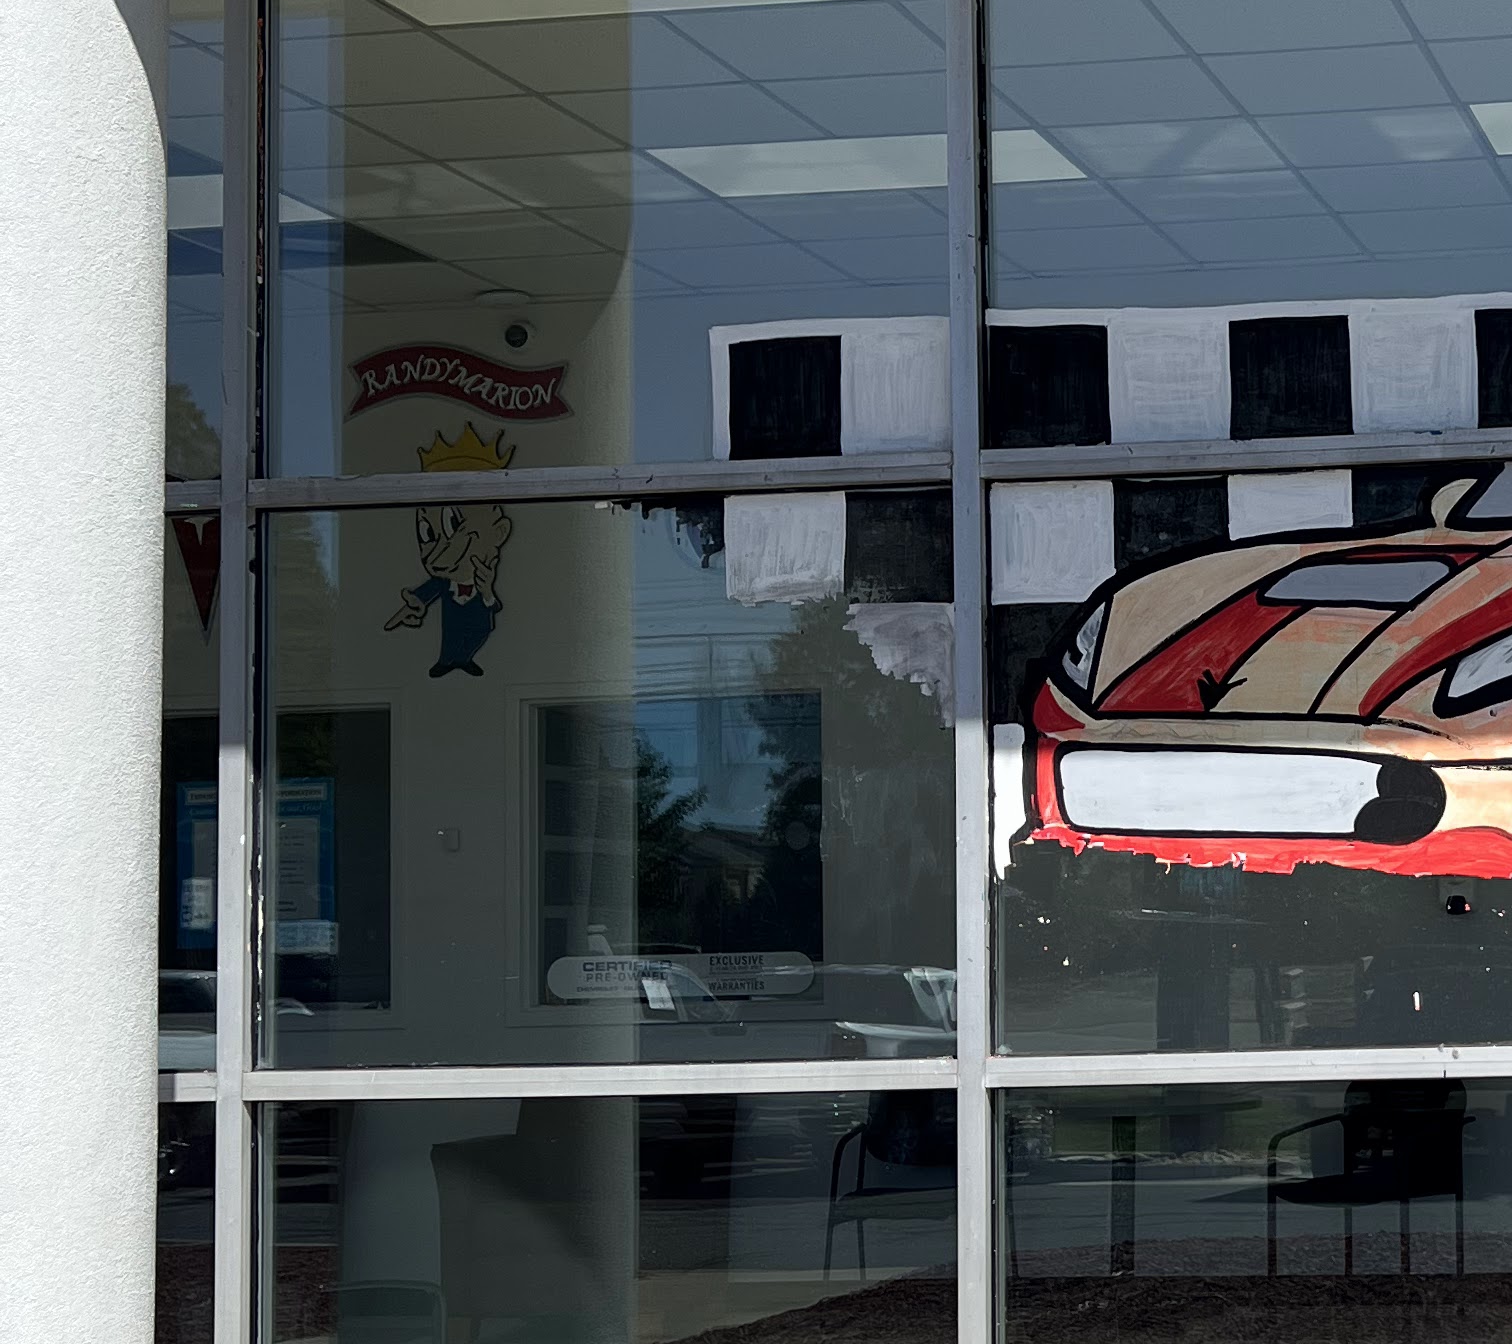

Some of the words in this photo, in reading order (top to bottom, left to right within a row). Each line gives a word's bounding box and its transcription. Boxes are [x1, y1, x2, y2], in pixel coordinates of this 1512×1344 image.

[360, 354, 460, 398] RANDY
[448, 365, 557, 411] MARION
[582, 959, 673, 973] CERTIFIED
[709, 954, 765, 966] EXCLUSIVE
[586, 971, 669, 982] PRE-OWNED
[707, 981, 766, 991] WARRANTIES
